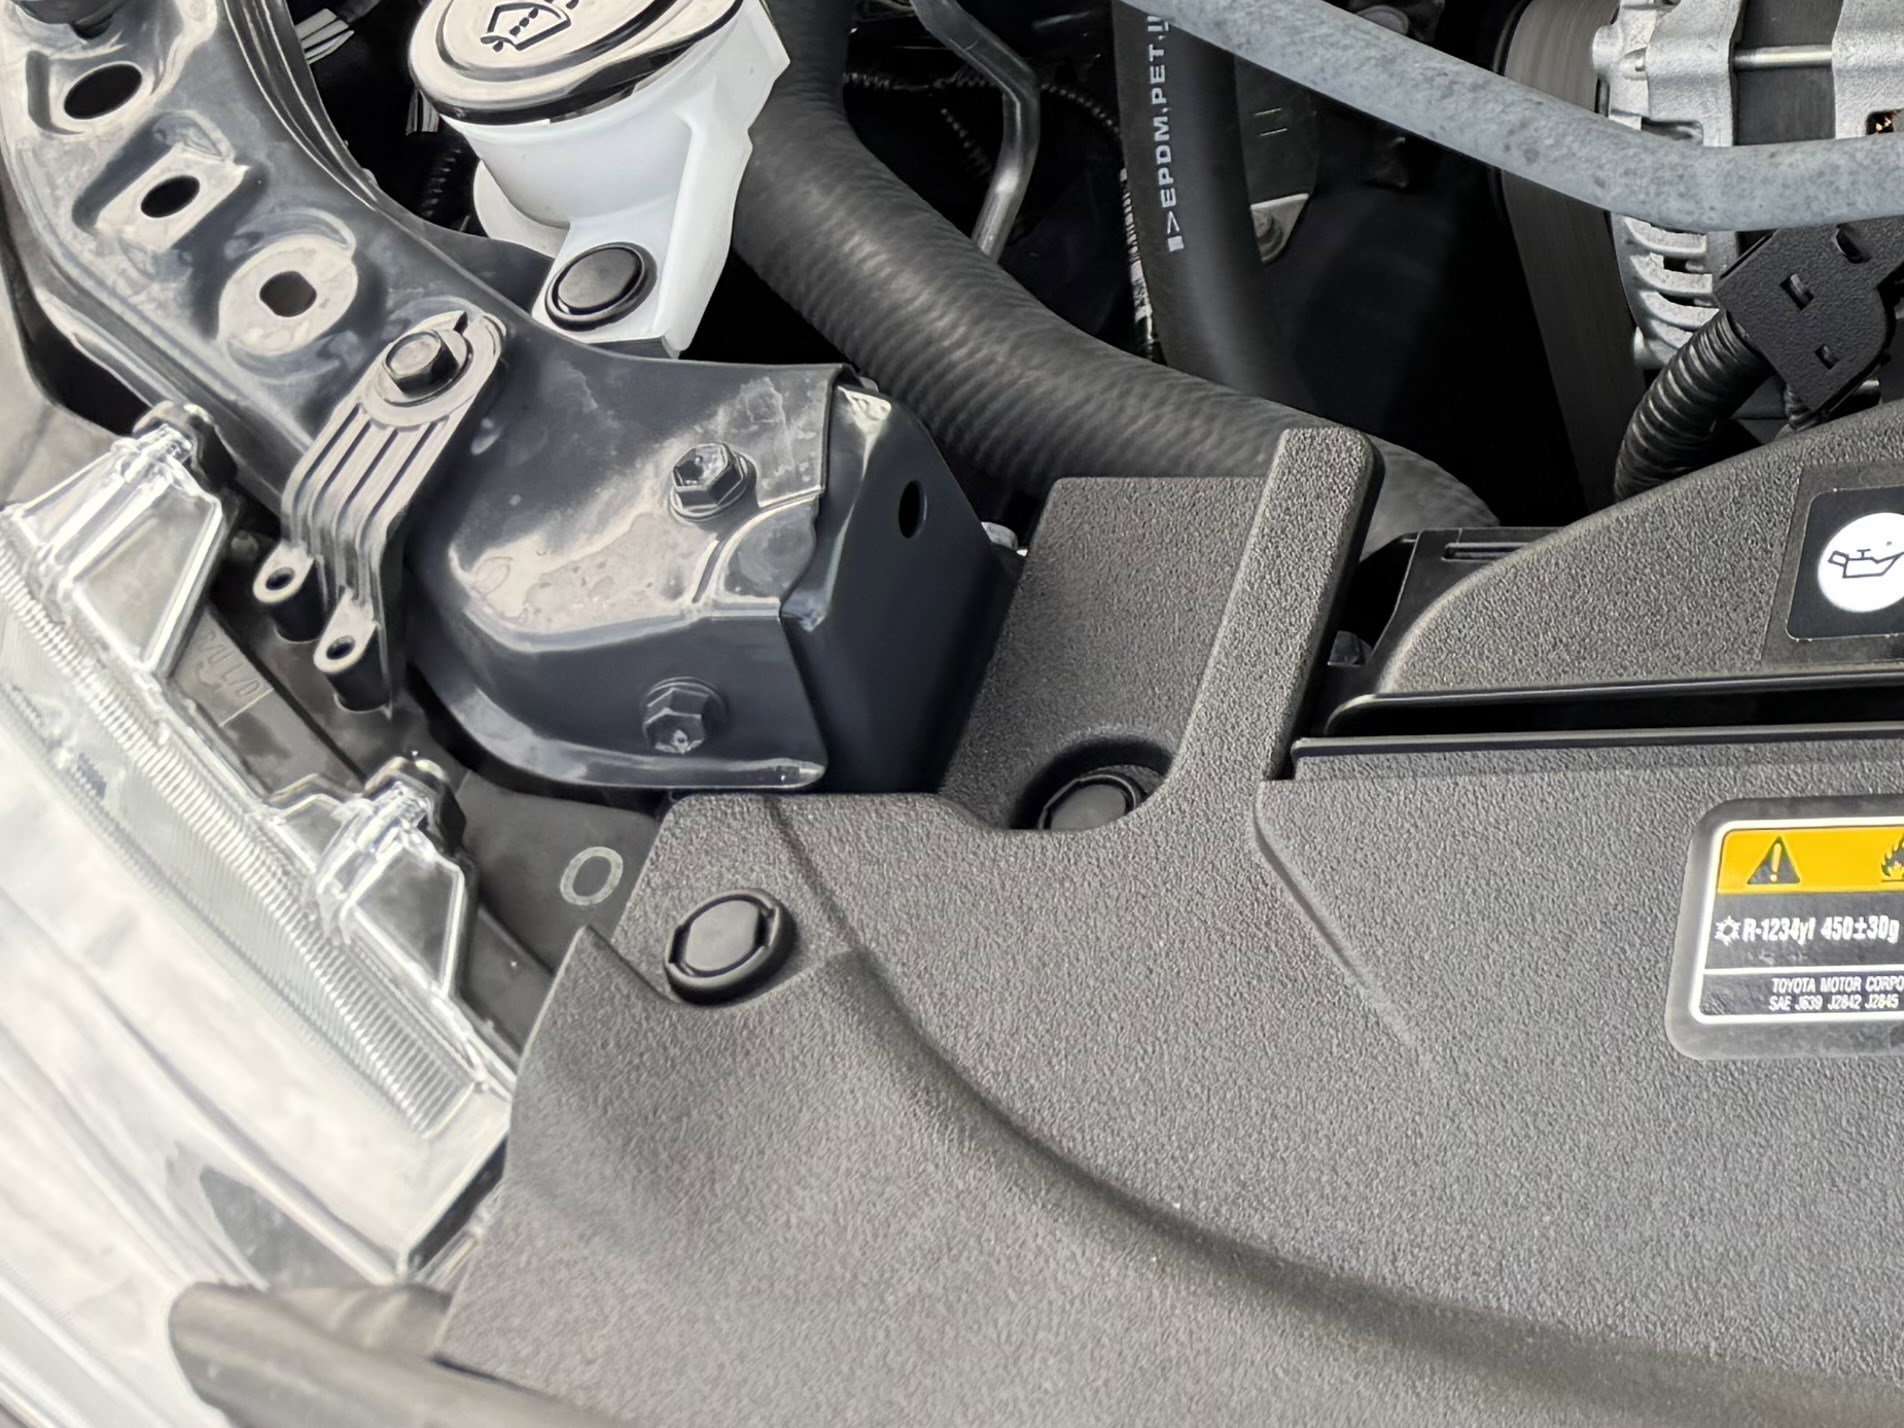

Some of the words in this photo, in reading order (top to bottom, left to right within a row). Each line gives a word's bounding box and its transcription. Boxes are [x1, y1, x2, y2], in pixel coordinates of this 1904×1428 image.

[1820, 914, 1900, 945] 450±30g
[1771, 976, 1817, 994] TOYOTA
[1820, 975, 1862, 993] MOTOR
[1768, 995, 1792, 1012] SAE
